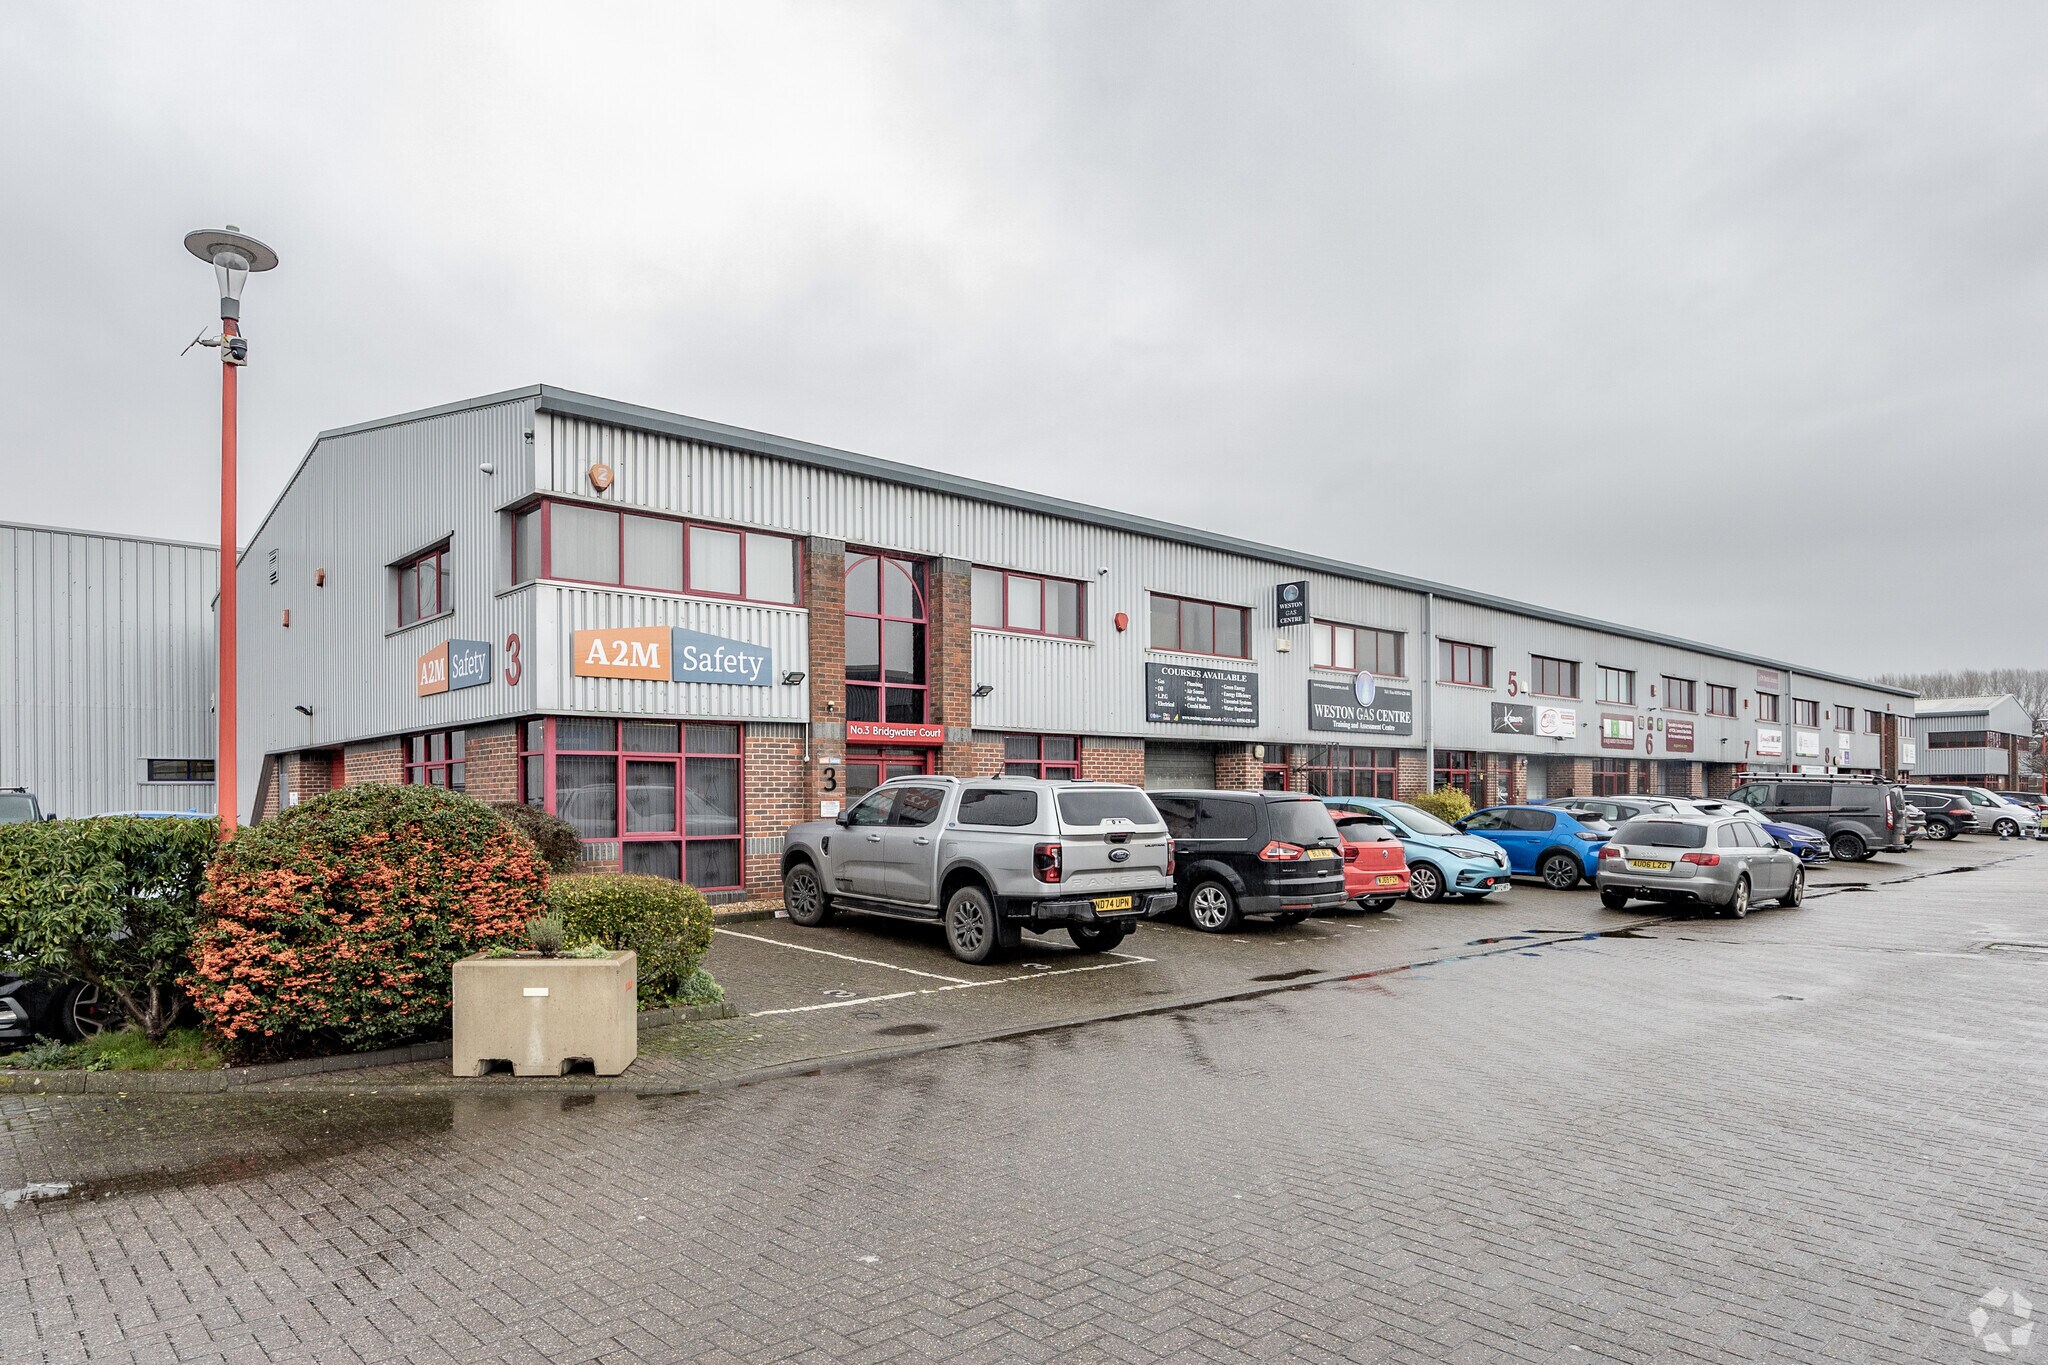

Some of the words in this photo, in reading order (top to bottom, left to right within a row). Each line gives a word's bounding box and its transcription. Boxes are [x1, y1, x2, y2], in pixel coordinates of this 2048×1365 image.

[1280, 602, 1303, 610] WESTON
[420, 658, 446, 686] A2M
[452, 649, 486, 680] Safety
[505, 633, 521, 686] 3
[585, 638, 661, 669] A2M
[682, 645, 764, 681] Safety
[1161, 667, 1202, 678] COURSES
[1202, 671, 1248, 682] AVAILABLE
[1507, 671, 1518, 697] 5
[1314, 704, 1354, 719] WESTON
[1356, 708, 1374, 721] GAS
[1376, 709, 1412, 724] CENTRE
[850, 724, 870, 735] No.3
[873, 726, 916, 738] Bridgwater
[919, 728, 941, 737] Court
[1333, 720, 1350, 729] Training
[1646, 733, 1654, 754] 6
[1744, 740, 1750, 759] 7
[1825, 747, 1830, 763] 8
[824, 768, 837, 792] 3
[1632, 860, 1651, 868] AU06
[1072, 874, 1160, 888] RANGER
[1115, 898, 1129, 908] UPN
